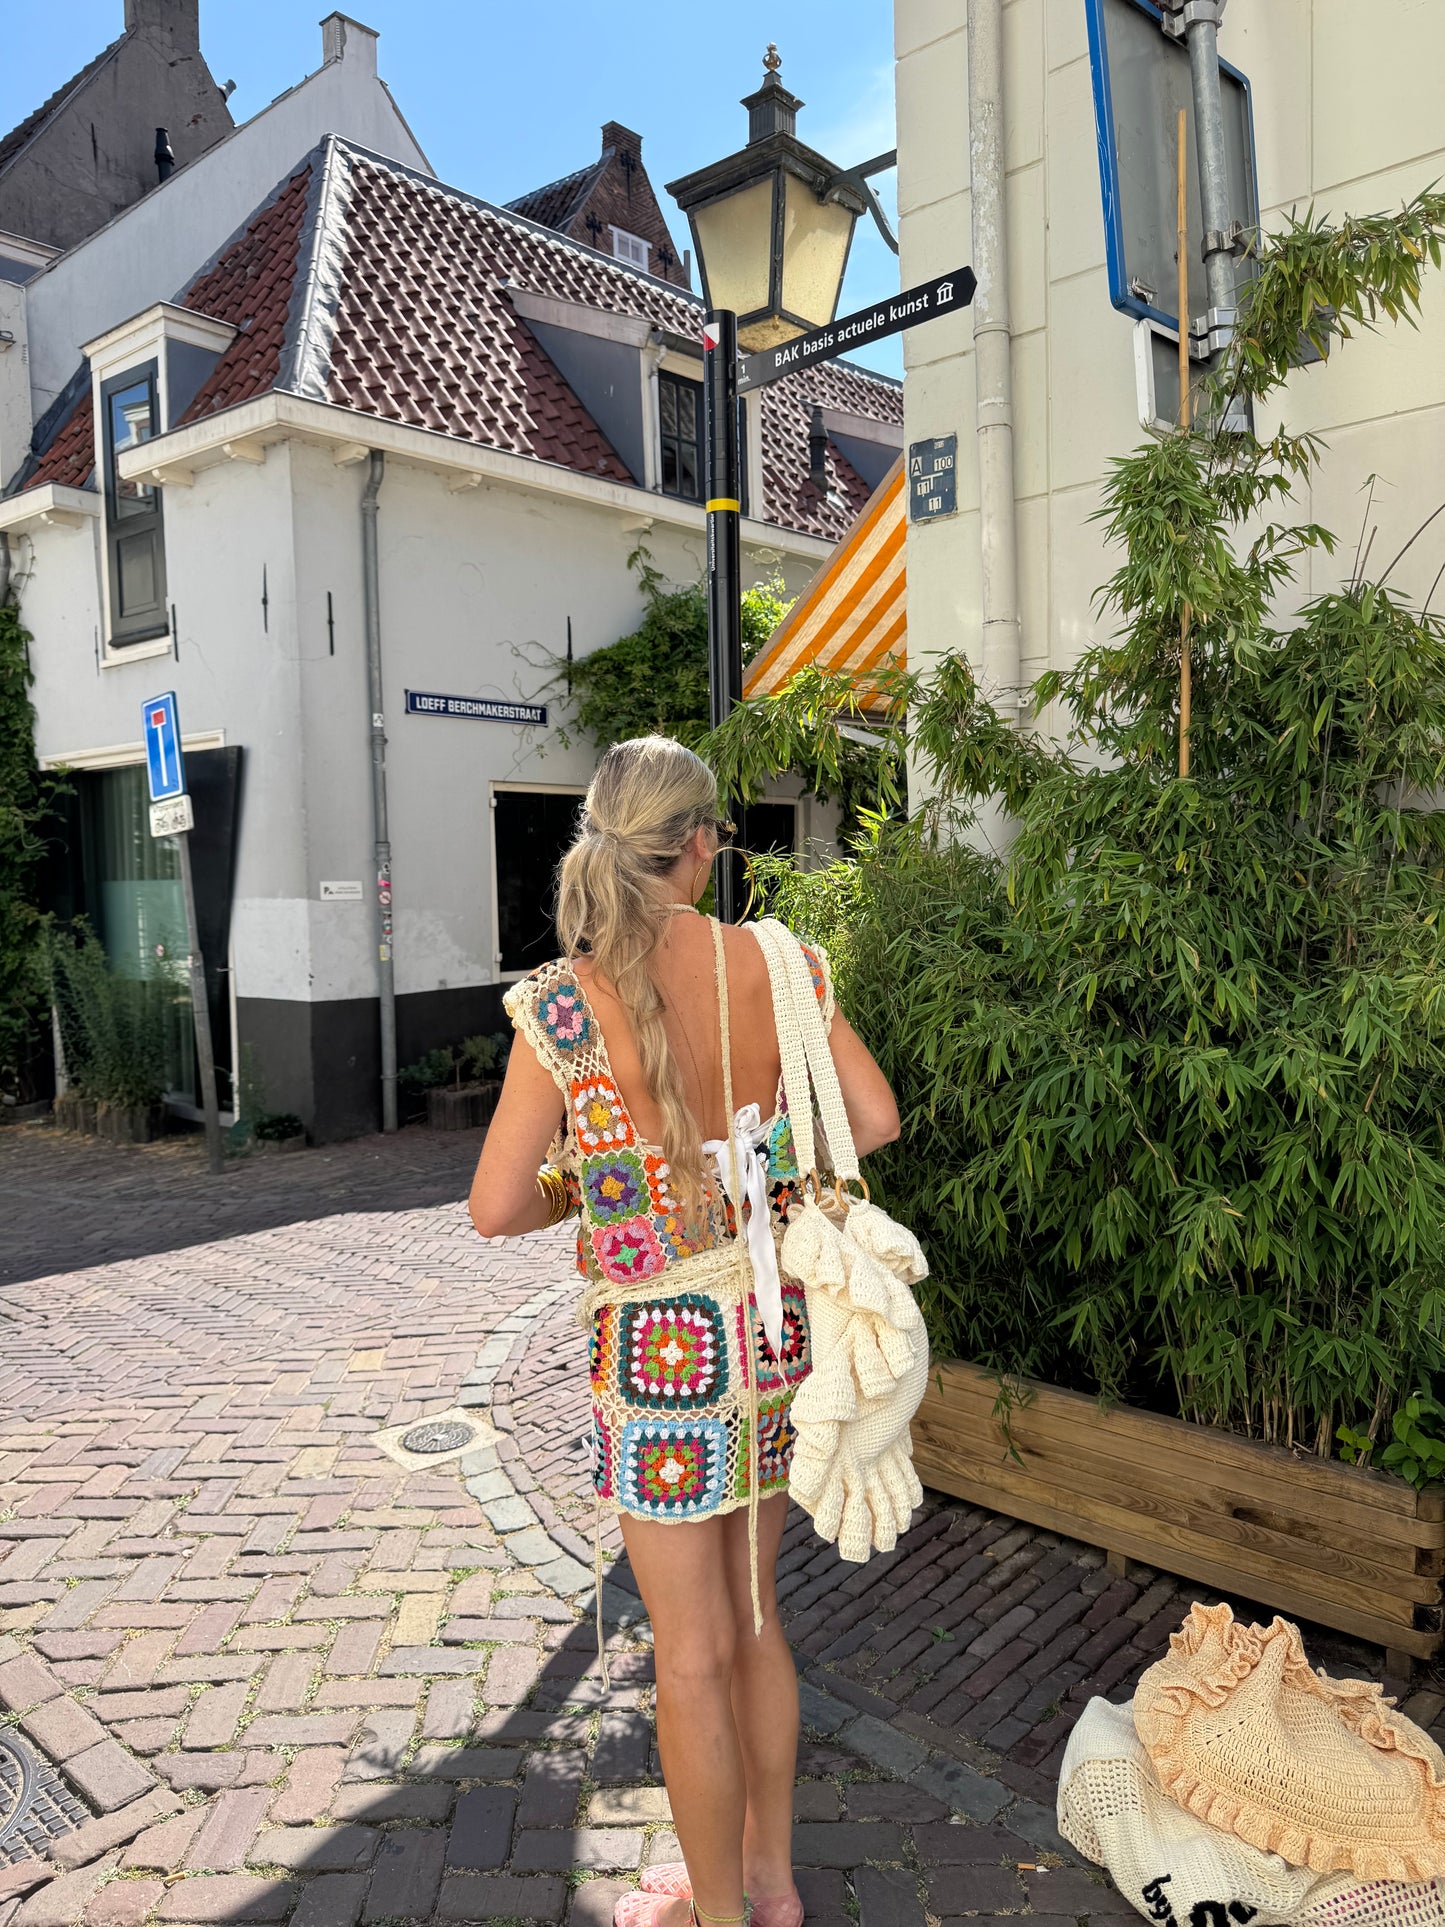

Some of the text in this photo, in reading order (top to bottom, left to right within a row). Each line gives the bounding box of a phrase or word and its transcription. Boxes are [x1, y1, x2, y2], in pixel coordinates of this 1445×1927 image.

[774, 293, 929, 368] BAK basis actuele kunst
[740, 363, 746, 375] 1
[911, 456, 952, 476] A 100
[918, 482, 929, 495] 11
[930, 497, 941, 510] 11
[415, 696, 542, 721] LOEFF BERCHMAKERSTRAAT
